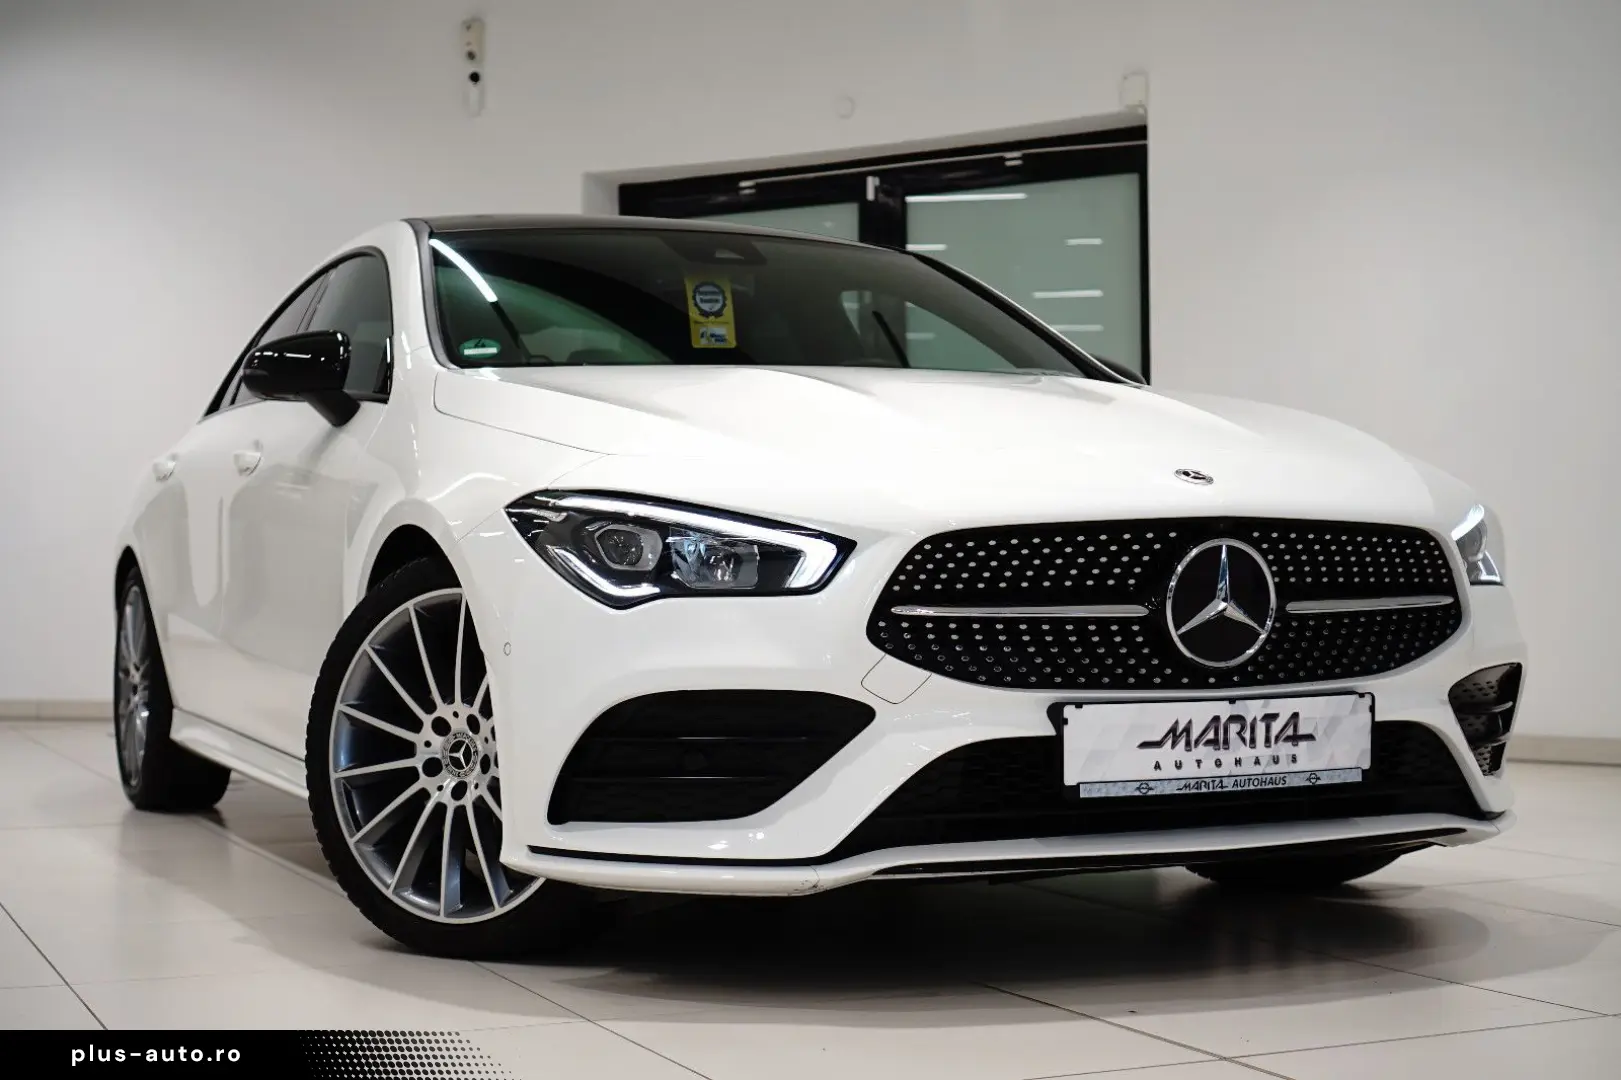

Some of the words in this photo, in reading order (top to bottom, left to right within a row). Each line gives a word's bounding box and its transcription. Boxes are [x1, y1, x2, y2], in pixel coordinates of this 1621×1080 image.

[1137, 712, 1316, 752] MARITA
[1153, 754, 1298, 771] AUTOHAUS
[1177, 779, 1228, 792] MARITA
[1232, 776, 1287, 788] AUTOHAUS
